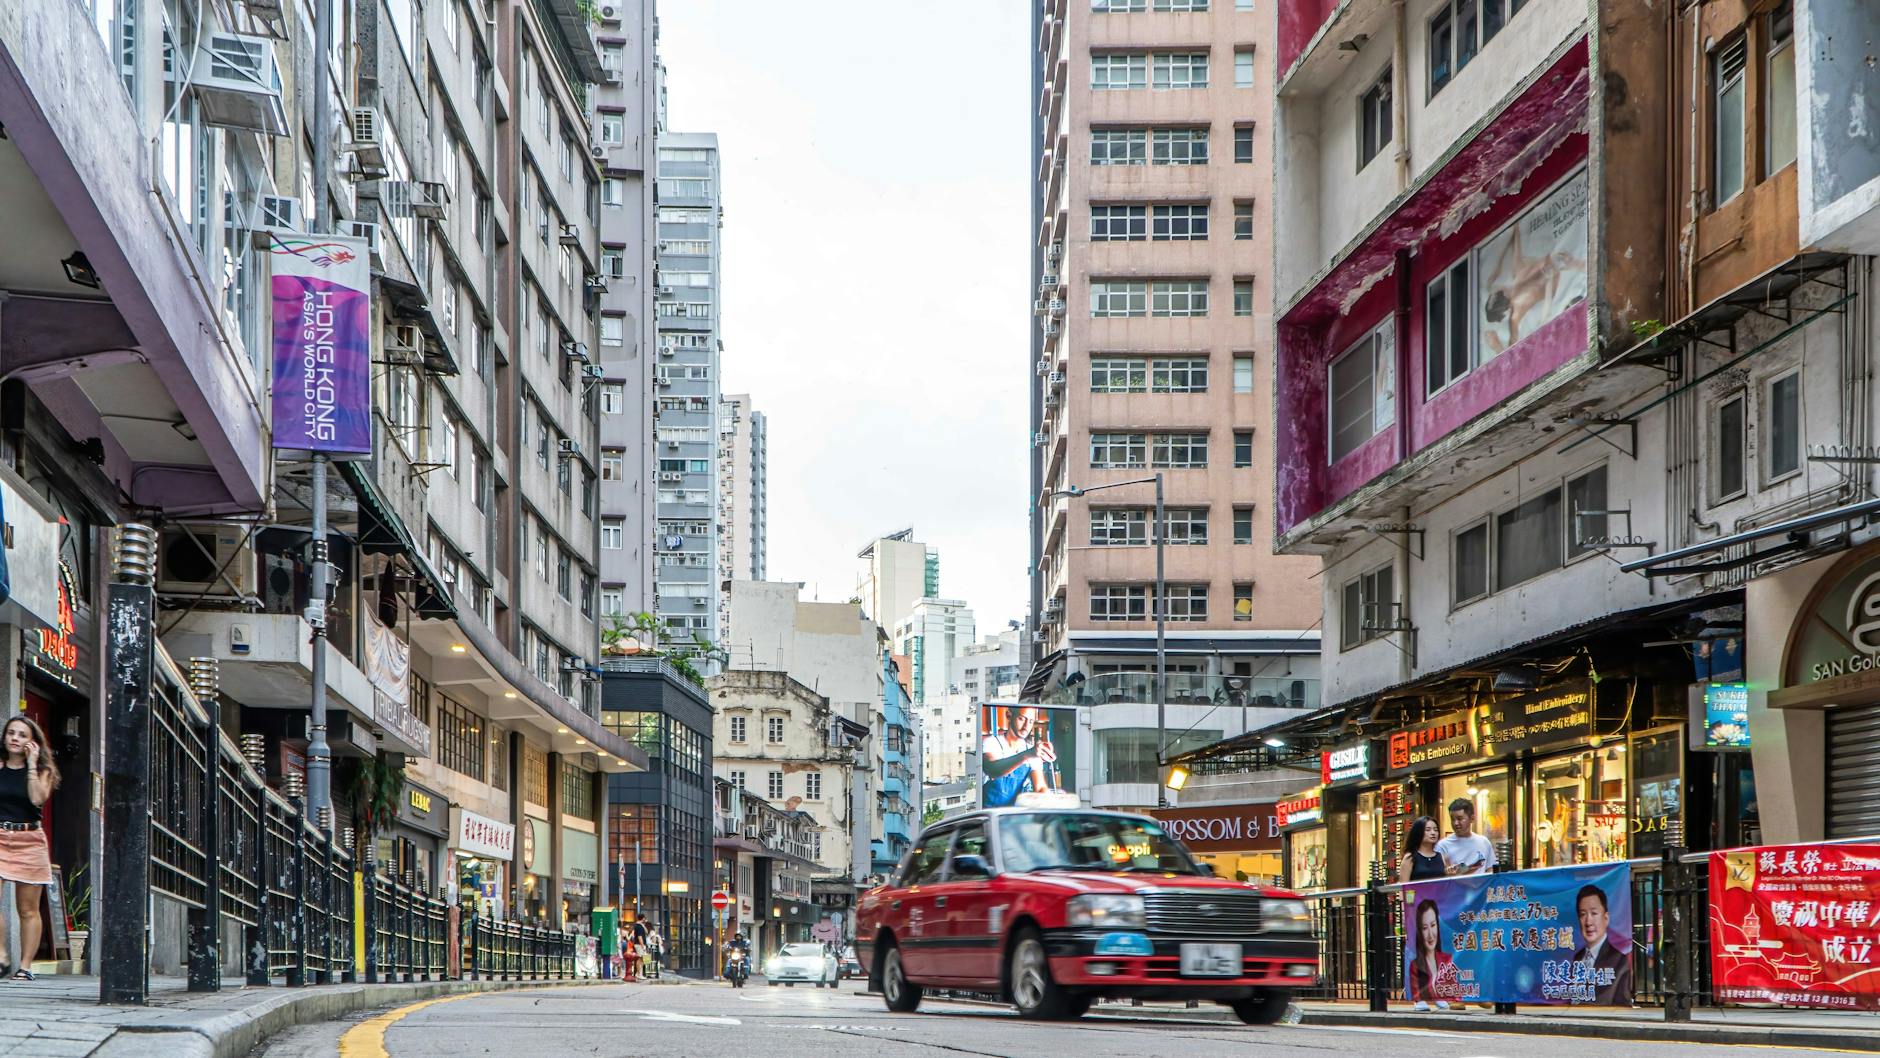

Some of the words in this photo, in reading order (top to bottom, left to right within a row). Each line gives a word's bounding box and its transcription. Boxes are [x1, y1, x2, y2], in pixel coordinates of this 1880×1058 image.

[303, 291, 316, 340] ASIA'S
[316, 291, 335, 363] HONG
[303, 344, 316, 399] WORLD
[316, 368, 336, 440] KONG
[304, 402, 316, 439] CITY
[1812, 657, 1844, 681] SAN
[375, 689, 402, 730] TRIBAL
[402, 711, 423, 744] RUGS
[1410, 752, 1425, 764] Gu's
[1158, 816, 1242, 842] BLOSSOM
[1246, 816, 1260, 839] &
[1267, 816, 1283, 838] B
[1759, 850, 1822, 875] 蘇長榮
[1511, 926, 1576, 951] 歡慶滿城
[1821, 935, 1873, 964] 成立
[1811, 995, 1821, 1003] 13
[1831, 996, 1848, 1005] 1316
